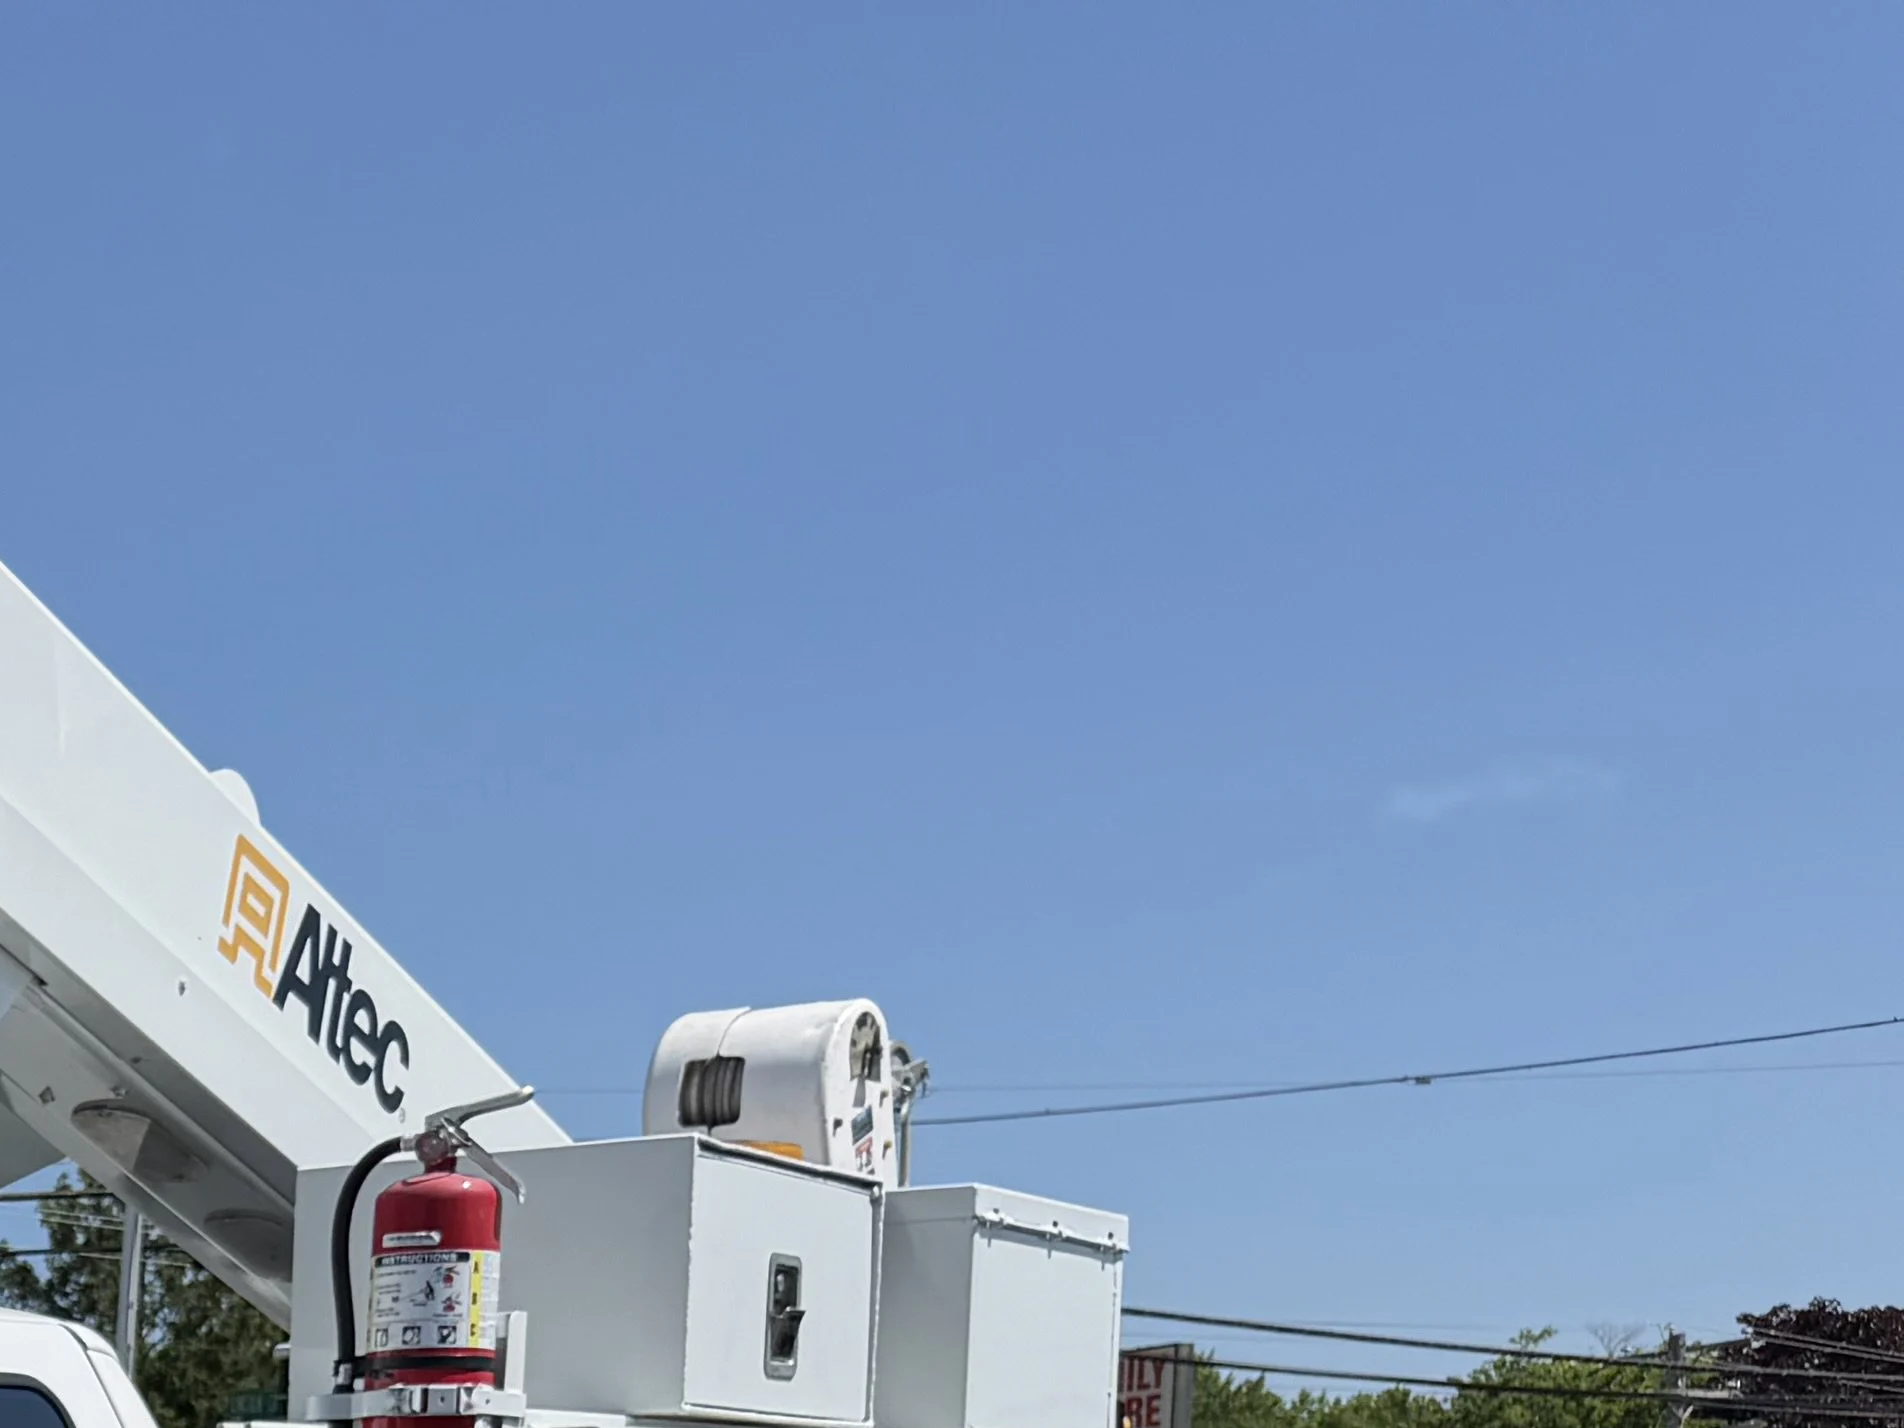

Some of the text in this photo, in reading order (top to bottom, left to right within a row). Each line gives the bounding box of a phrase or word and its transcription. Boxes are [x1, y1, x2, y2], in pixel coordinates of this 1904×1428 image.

[272, 902, 410, 1114] Altec
[382, 1253, 457, 1265] INSTRUCTIONS
[1119, 1357, 1165, 1392] ILY
